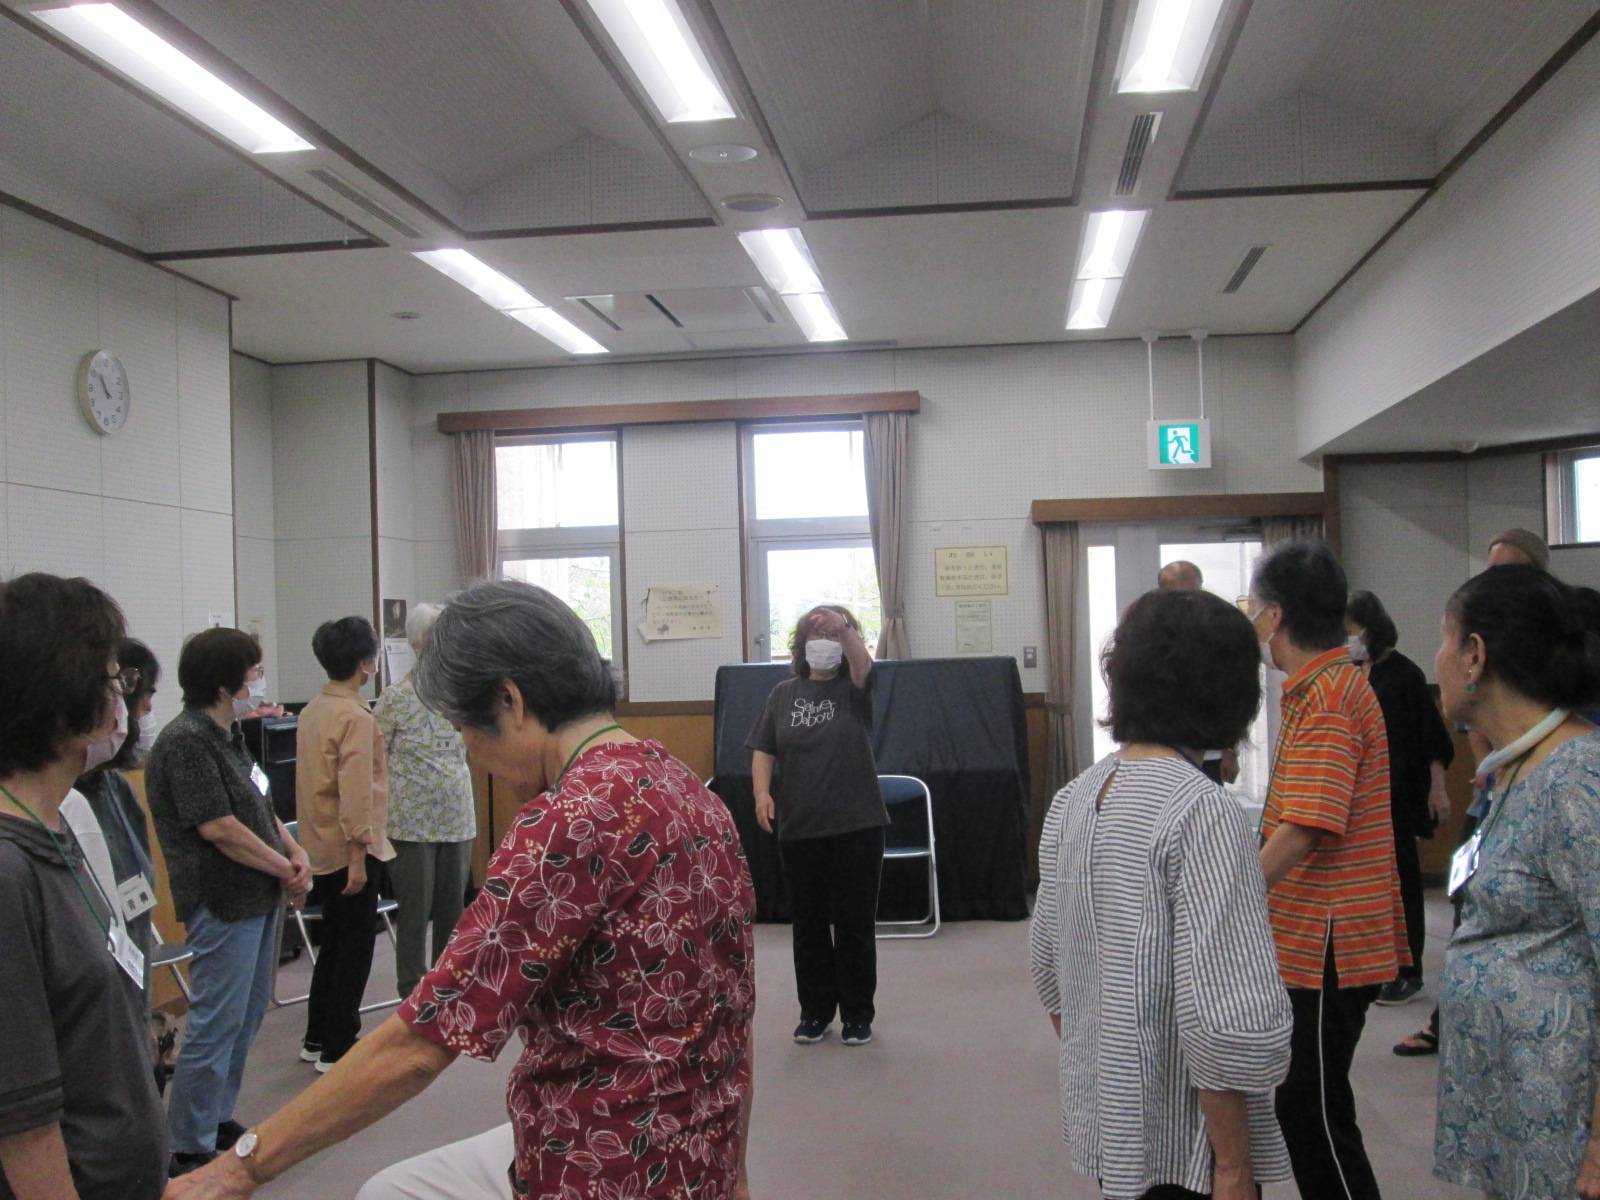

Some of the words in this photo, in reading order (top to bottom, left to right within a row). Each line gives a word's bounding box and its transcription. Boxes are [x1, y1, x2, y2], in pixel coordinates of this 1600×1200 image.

[116, 376, 122, 386] 2
[88, 383, 94, 393] 9
[118, 391, 124, 401] 3
